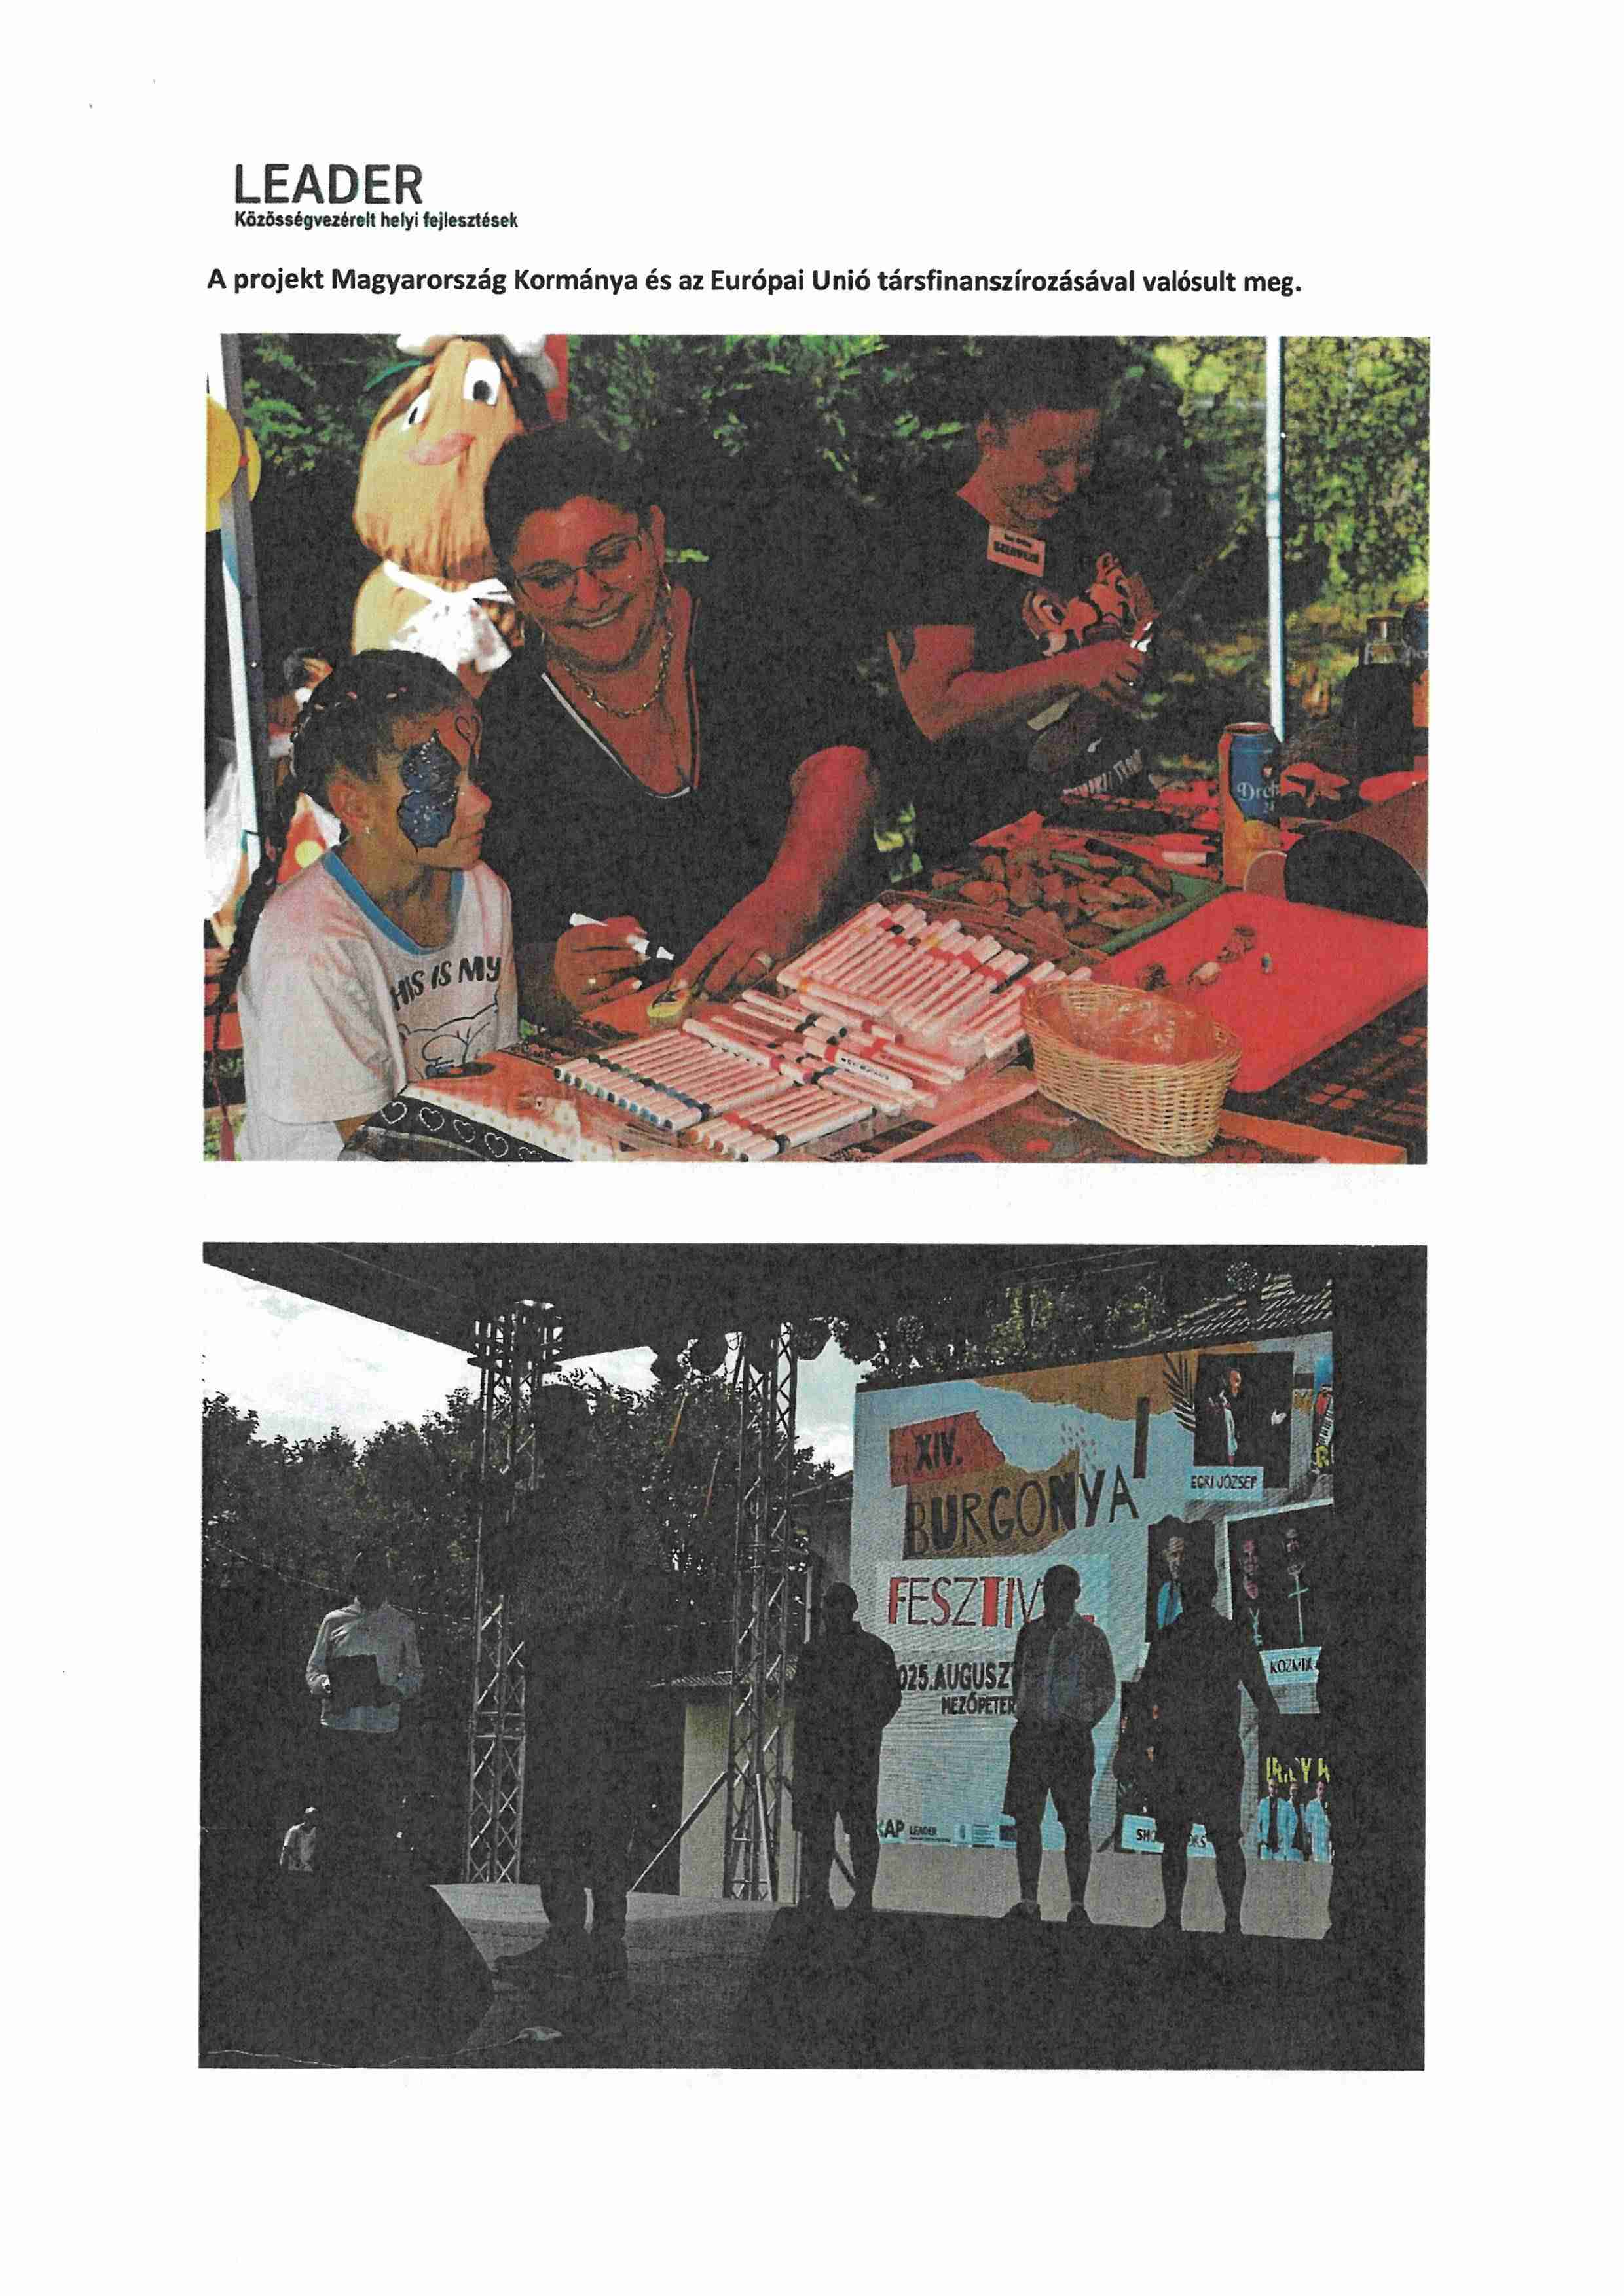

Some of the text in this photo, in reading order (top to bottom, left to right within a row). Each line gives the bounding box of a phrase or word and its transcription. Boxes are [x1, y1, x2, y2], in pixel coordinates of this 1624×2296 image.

[236, 164, 422, 204] LEADER
[236, 211, 518, 231] Közösségvezérelt helyi fejlesztések
[208, 267, 1301, 297] A projekt Magyarország Kormánya és az Európai Unió társfinanszírozásával valósult meg.
[390, 955, 502, 1011] HIS IS MY
[913, 1429, 963, 1471] XIV.
[904, 1464, 1140, 1558] BURGONYA
[888, 1576, 1094, 1628] FESZTIV
[898, 1661, 1014, 1691] 025.AUGUSZ
